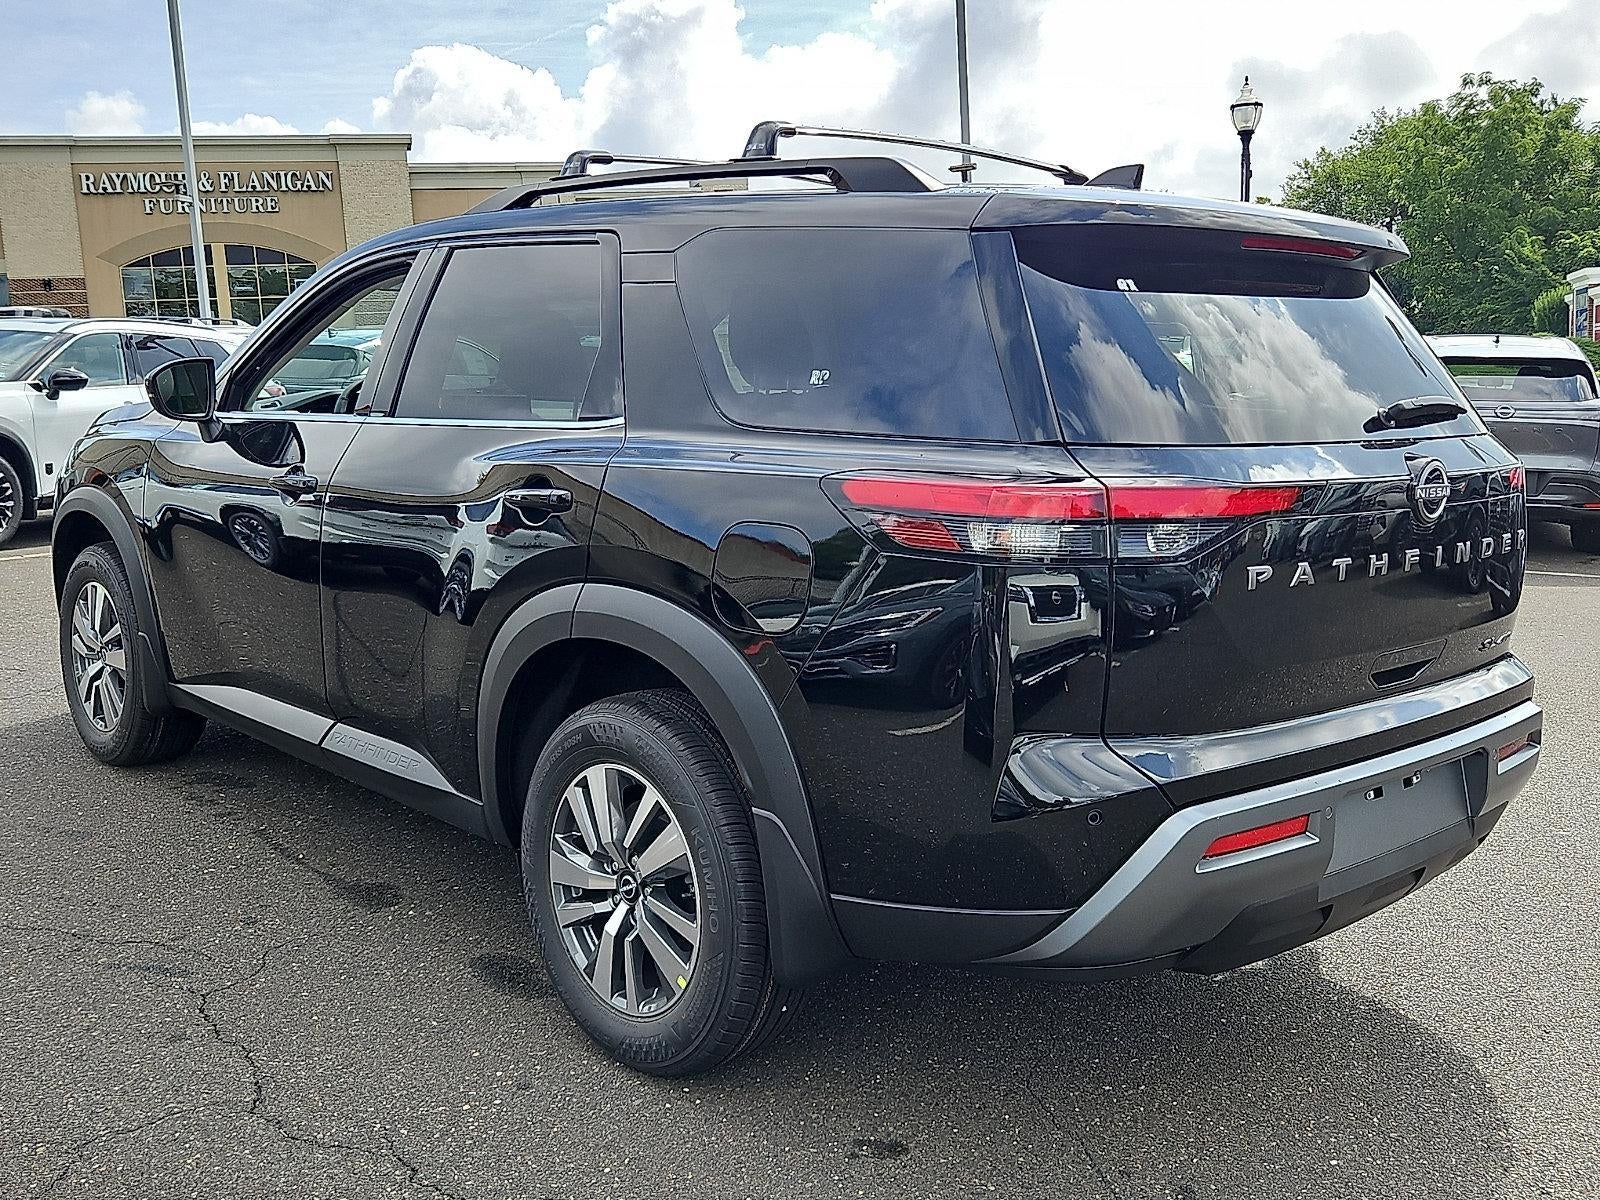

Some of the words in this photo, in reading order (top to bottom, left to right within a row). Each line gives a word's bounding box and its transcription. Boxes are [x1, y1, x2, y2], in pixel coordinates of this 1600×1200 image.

[199, 170, 215, 191] &
[218, 170, 333, 192] FLANIGAN
[1247, 529, 1525, 590] PATHFINDER
[329, 731, 421, 771] PATHFINDER
[690, 825, 719, 933] KUMHO
